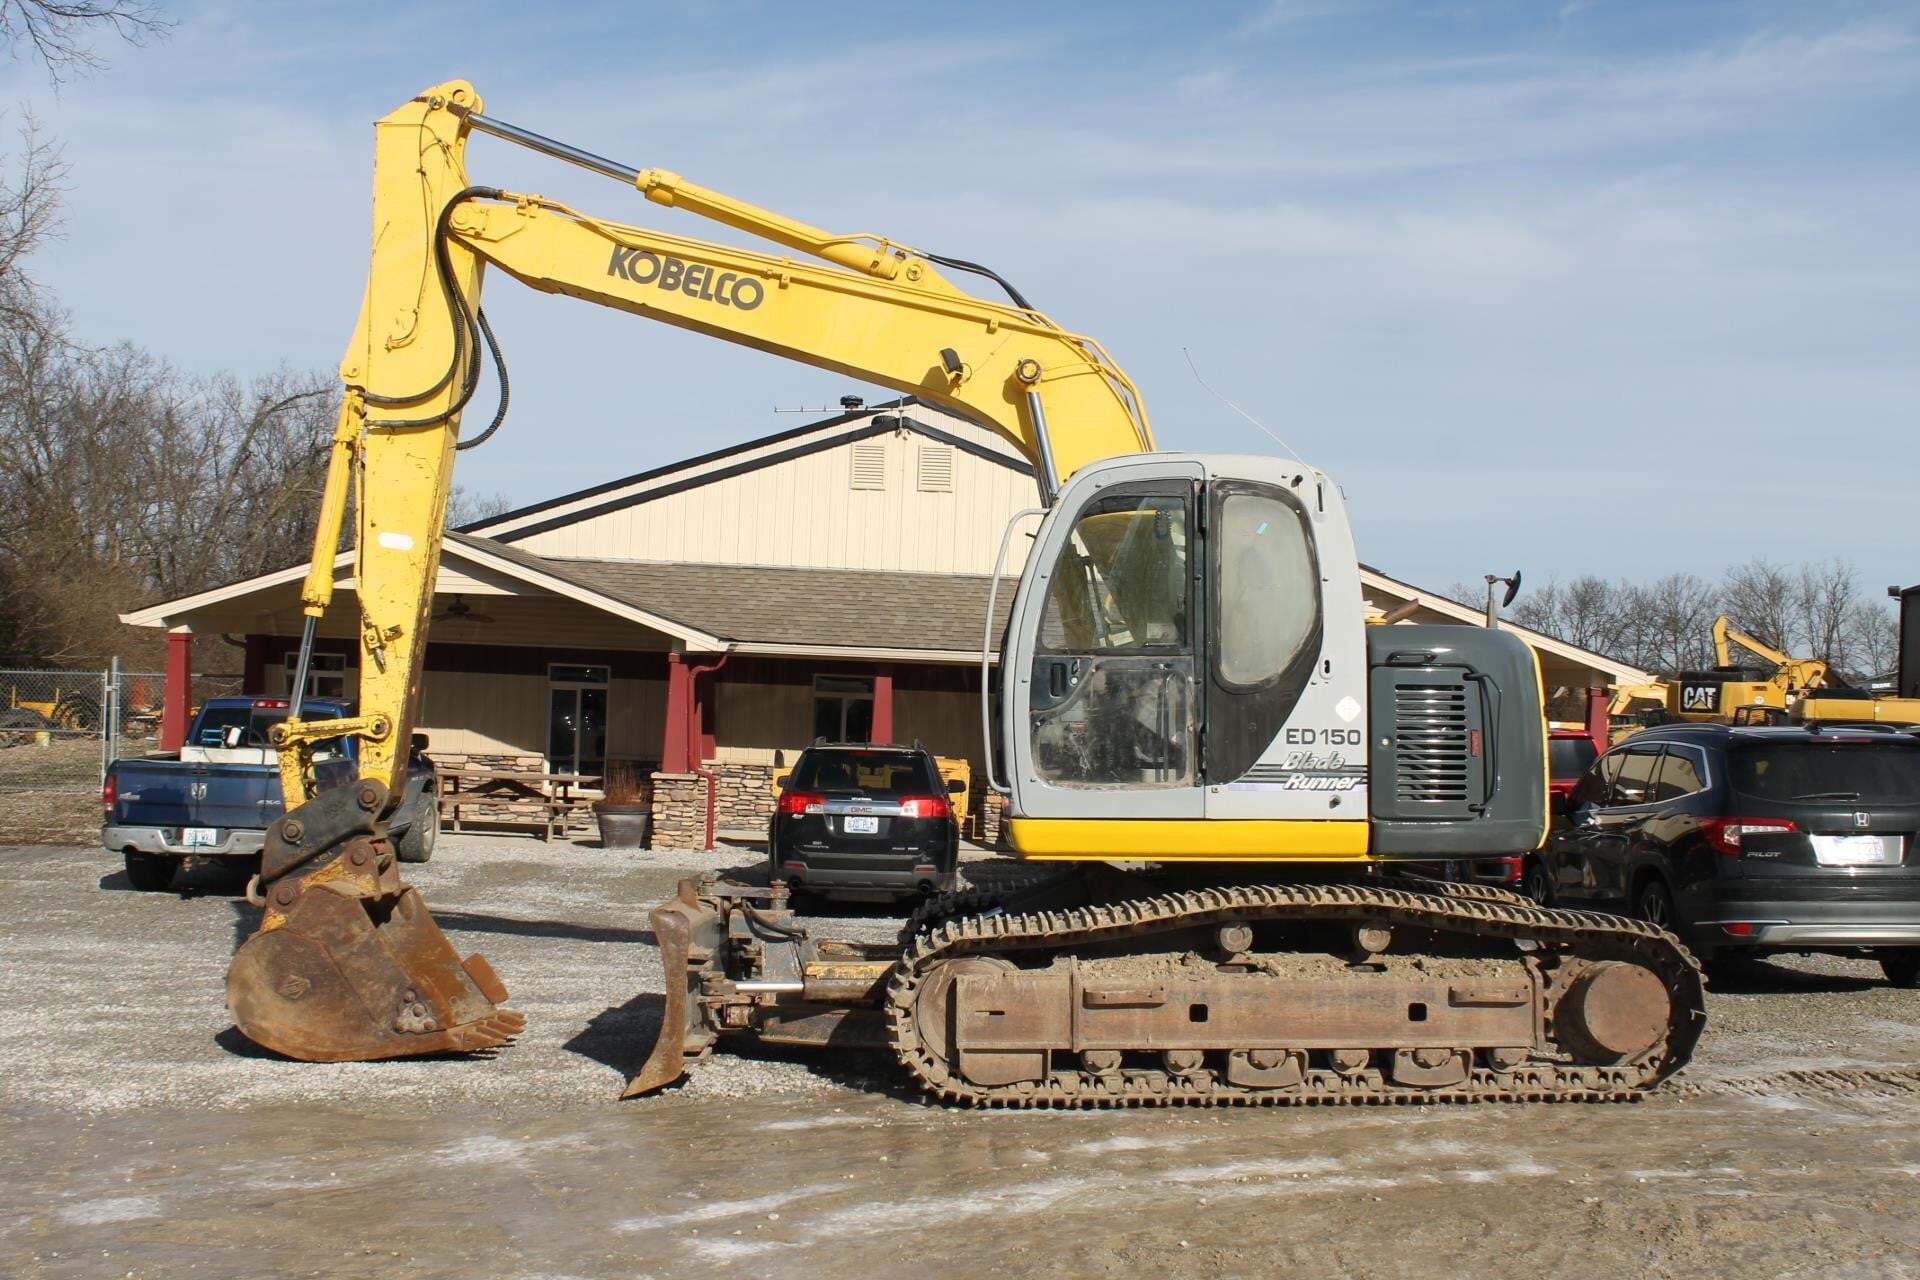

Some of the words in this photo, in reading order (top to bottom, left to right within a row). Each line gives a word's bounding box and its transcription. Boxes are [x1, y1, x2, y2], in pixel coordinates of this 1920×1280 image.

[607, 243, 764, 311] KOBELCO
[1683, 687, 1716, 709] CAT
[1280, 751, 1345, 770] Blade
[1283, 773, 1361, 790] Runner
